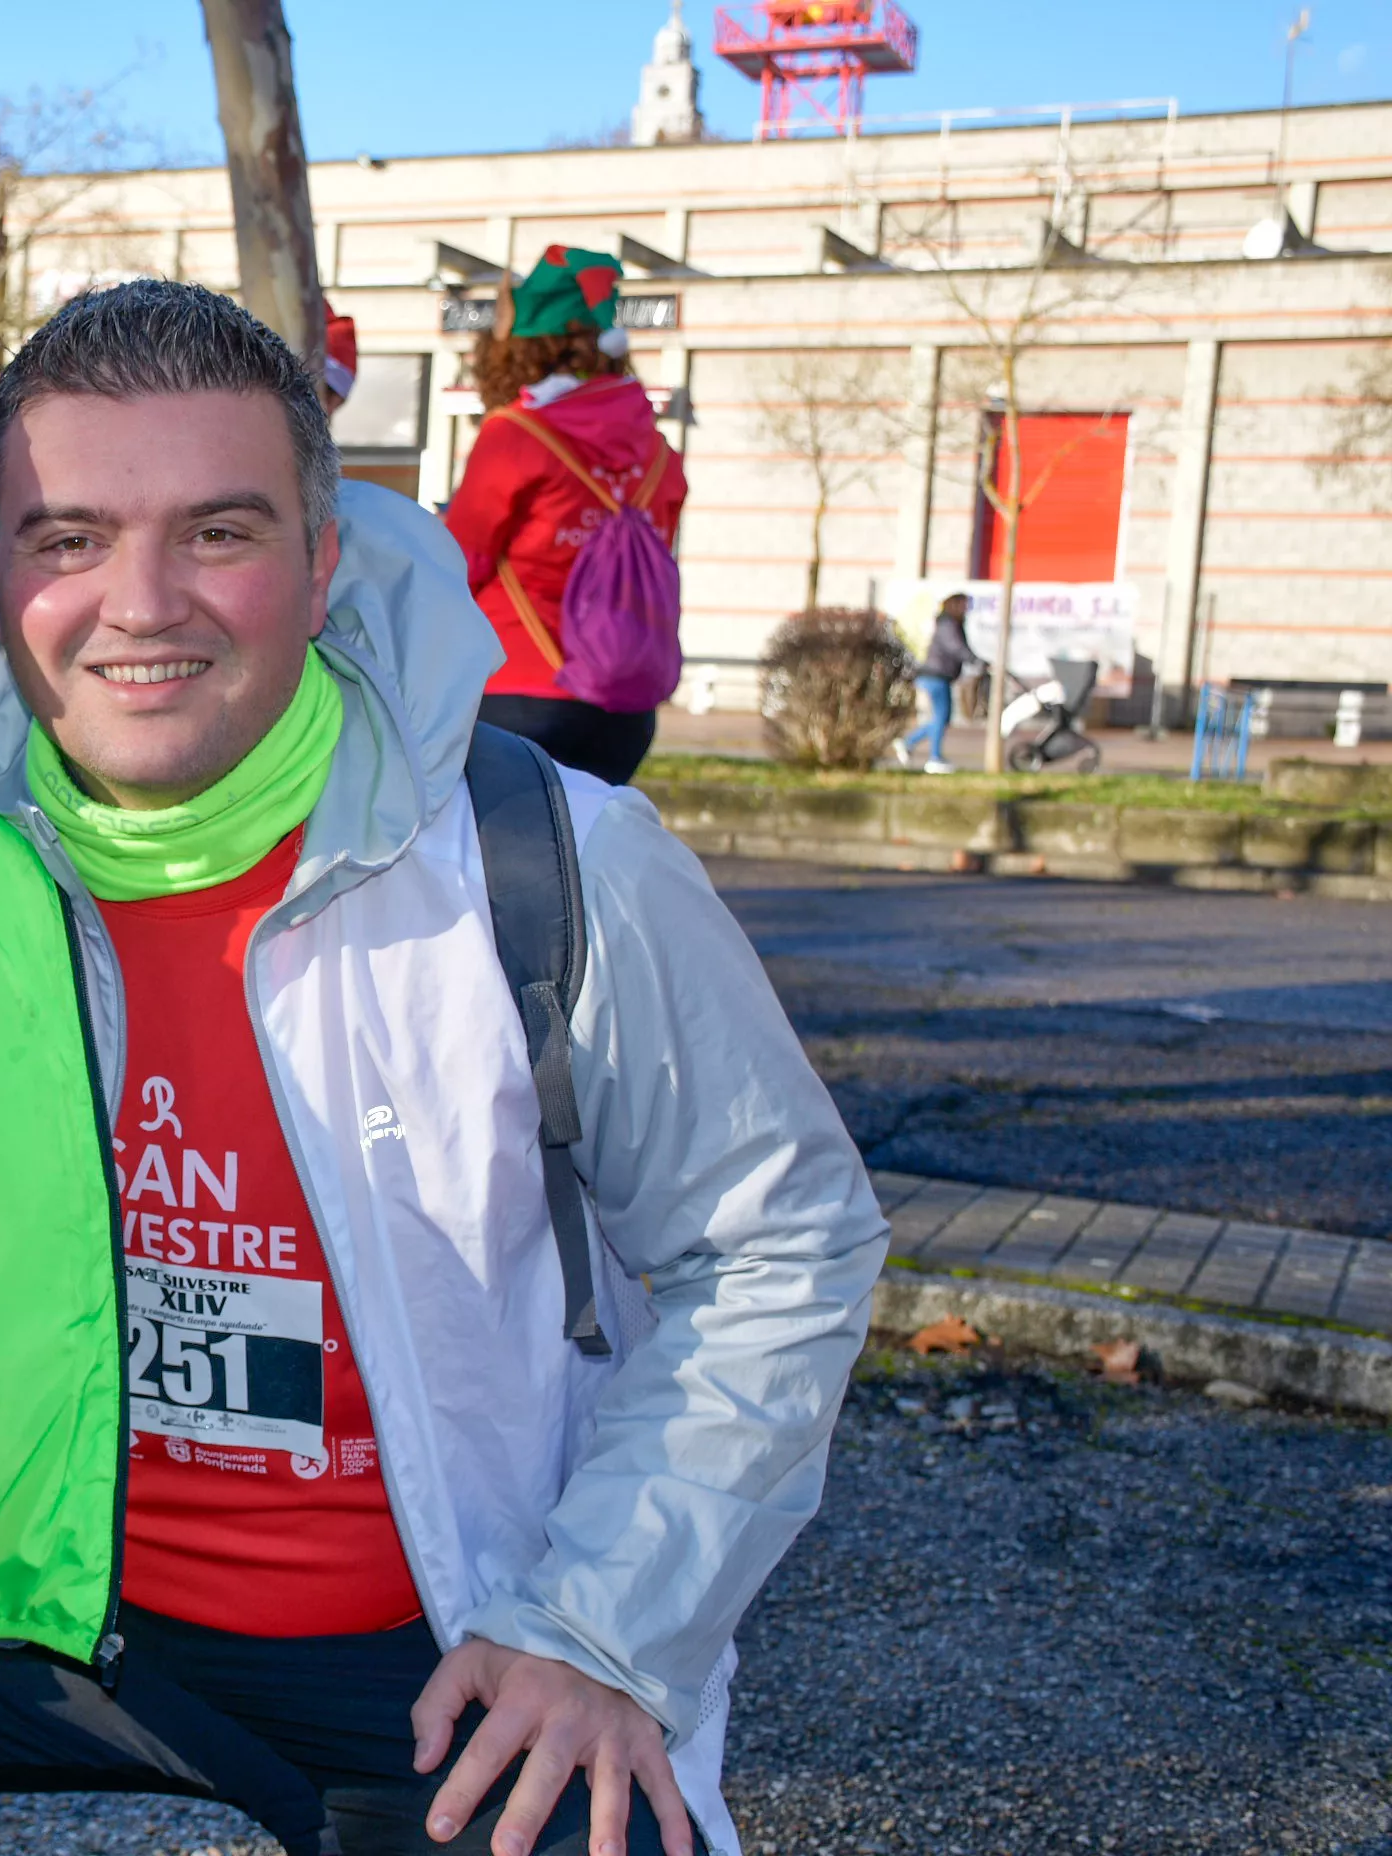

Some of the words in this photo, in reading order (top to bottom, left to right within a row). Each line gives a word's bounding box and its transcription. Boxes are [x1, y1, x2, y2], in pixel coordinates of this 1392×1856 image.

[163, 1273, 251, 1295] SILVESTRE
[159, 1285, 227, 1316] XLIV
[148, 1307, 185, 1322] comparte
[186, 1315, 217, 1328] tiempo
[129, 1316, 249, 1413] 251
[194, 1446, 267, 1464] Ayuntamiento
[194, 1455, 268, 1475] Ponferrada
